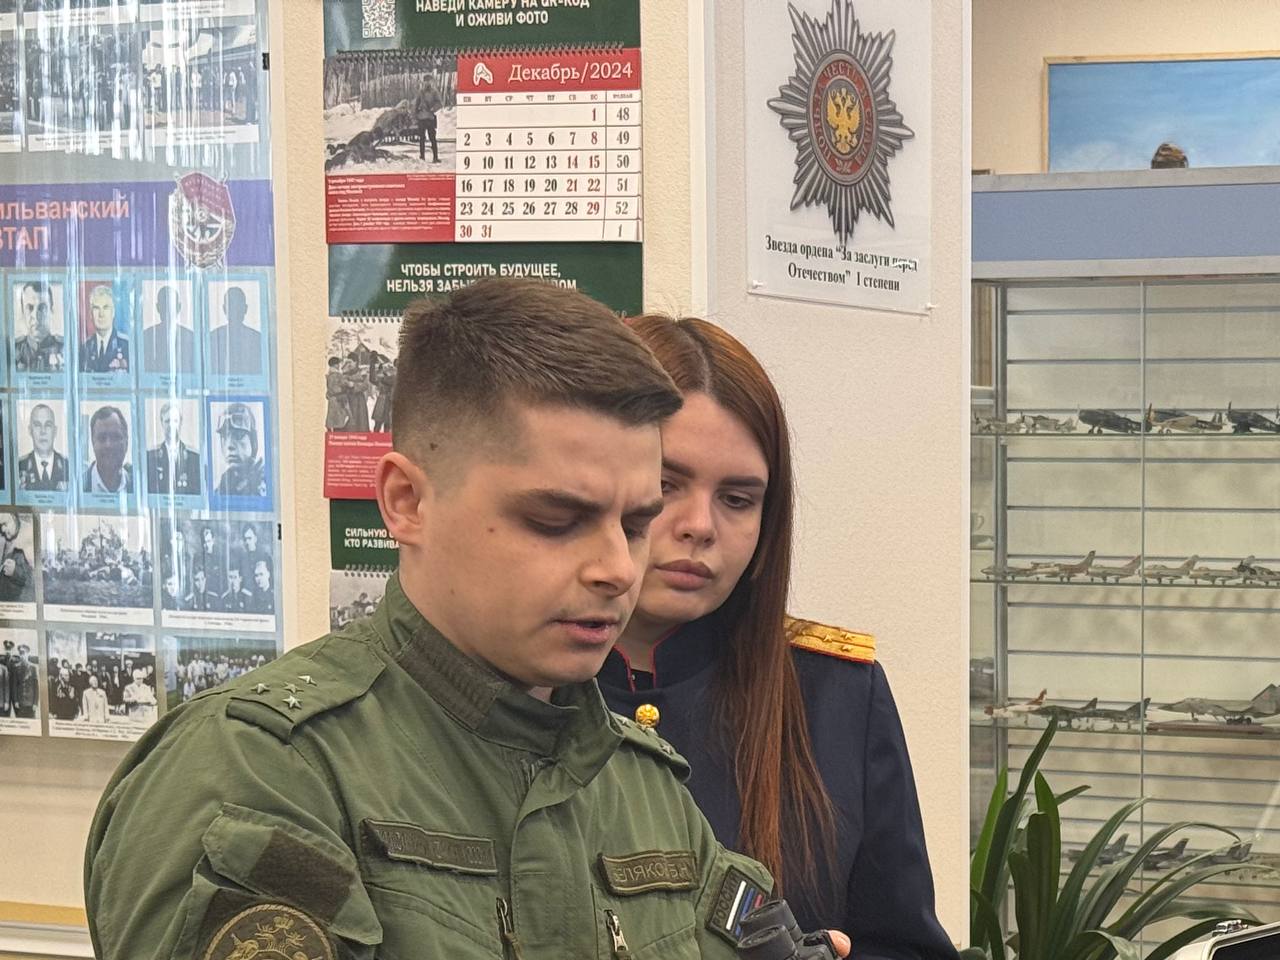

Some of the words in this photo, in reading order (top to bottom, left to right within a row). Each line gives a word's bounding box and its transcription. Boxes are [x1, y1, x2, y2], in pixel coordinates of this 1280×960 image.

[416, 0, 465, 13] НАВЕДИ
[468, 0, 521, 10] КАМЕРУ
[455, 14, 464, 27] И
[467, 11, 513, 26] ОЖИВИ
[516, 10, 549, 24] ФОТО
[508, 62, 633, 84] Декабрь/2024
[592, 108, 597, 122] 1
[616, 107, 630, 121] 48
[464, 133, 471, 146] 2
[485, 133, 492, 146] 3
[506, 133, 513, 146] 4
[527, 133, 533, 146] 5
[548, 132, 555, 146] 6
[570, 132, 576, 145] 7
[591, 131, 598, 145] 8
[616, 131, 630, 145] 49
[464, 158, 471, 170] 9
[483, 157, 494, 169] 10
[504, 156, 514, 169] 11
[525, 156, 536, 169] 12
[546, 155, 557, 169] 13
[567, 155, 578, 169] 14
[589, 155, 600, 168] 15
[616, 154, 630, 168] 50
[461, 179, 473, 192] 16
[482, 179, 494, 192] 17
[503, 179, 515, 192] 18
[524, 179, 535, 192] 19
[544, 178, 557, 192] 20
[566, 178, 578, 192] 21
[587, 178, 600, 192] 22
[616, 178, 629, 191] 51
[460, 202, 473, 215] 23
[481, 202, 494, 215] 24
[502, 202, 514, 215] 25
[523, 202, 535, 215] 26
[543, 202, 557, 215] 27
[565, 202, 578, 215] 28
[587, 201, 600, 215] 29
[615, 201, 629, 215] 52
[0, 225, 49, 250] ТАП
[460, 225, 472, 238] 30
[481, 225, 492, 238] 31
[618, 224, 622, 238] 1
[765, 234, 798, 254] Звезда
[800, 243, 833, 260] ордена
[854, 251, 890, 269] заслуги
[401, 264, 440, 277] ЧТОБЫ
[444, 264, 497, 277] СТРОИТЬ
[500, 263, 561, 278] БУДУЩЕЕ,
[387, 279, 433, 292] НЕЛЬЗЯ
[863, 276, 900, 291] степени
[345, 528, 387, 537] СИЛЬНУЮ
[344, 538, 360, 547] КТО
